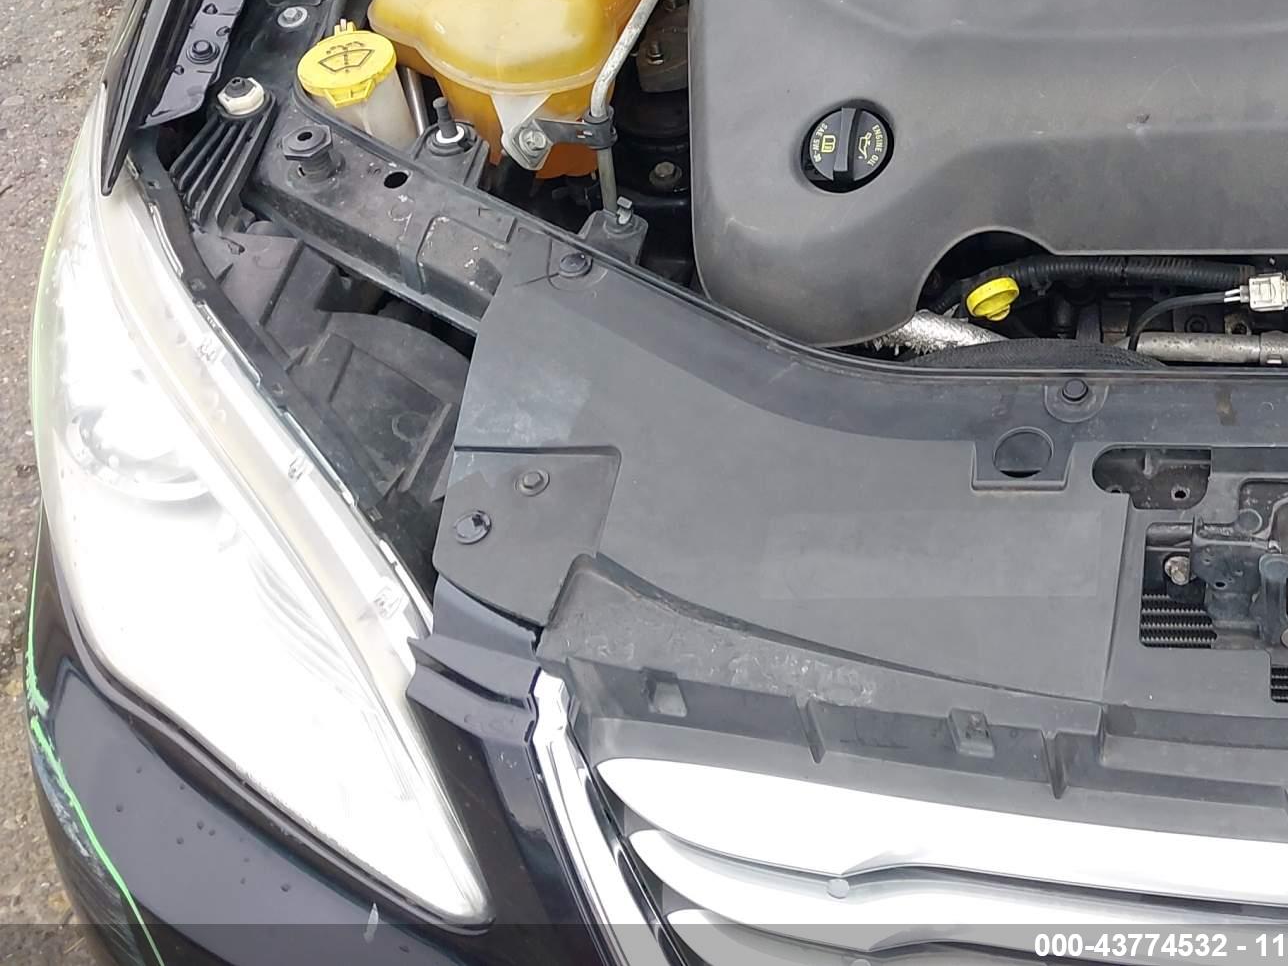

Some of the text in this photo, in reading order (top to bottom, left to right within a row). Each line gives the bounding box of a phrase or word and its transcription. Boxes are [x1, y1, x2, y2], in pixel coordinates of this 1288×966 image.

[815, 122, 828, 137] SAE
[866, 124, 884, 167] ENGINE OIL
